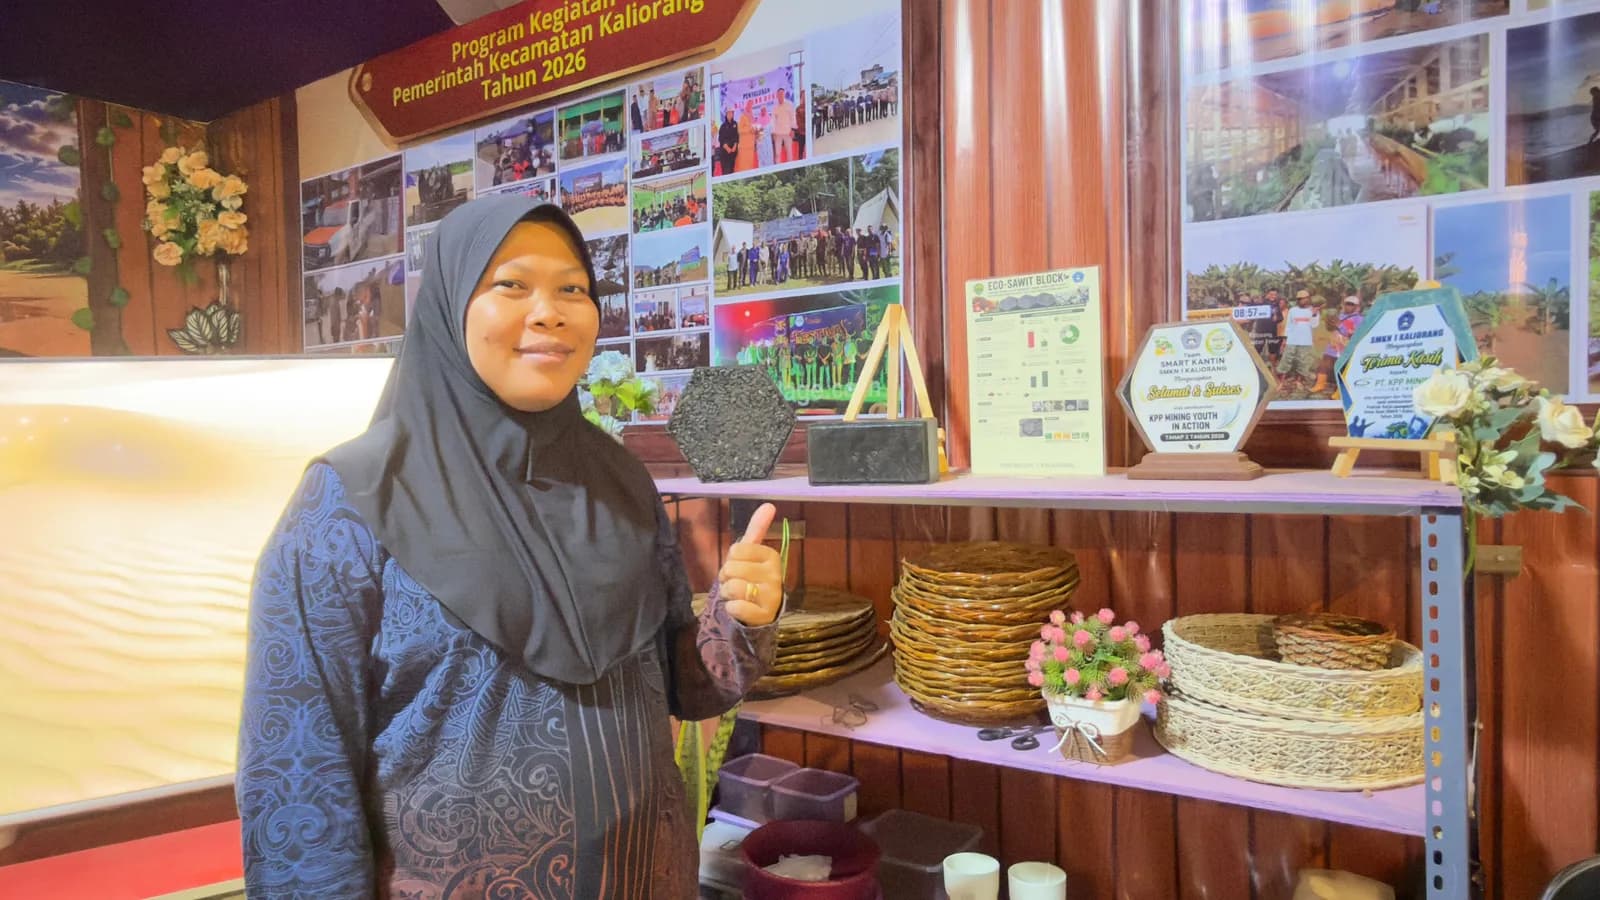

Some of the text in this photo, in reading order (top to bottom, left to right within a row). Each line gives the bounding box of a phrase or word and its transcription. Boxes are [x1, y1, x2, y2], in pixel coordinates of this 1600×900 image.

[452, 23, 524, 62] Program
[392, 58, 485, 107] Pemerintah
[489, 24, 593, 74] Kecamatan
[481, 49, 587, 100] Tahun 2026
[987, 276, 1034, 291] ECO-SAWIT
[1036, 273, 1064, 285] BLOCK
[1160, 357, 1225, 368] SMART KANTIN
[1150, 411, 1218, 422] KPP MINING YOUTH
[1172, 421, 1211, 430] IN ACTION
